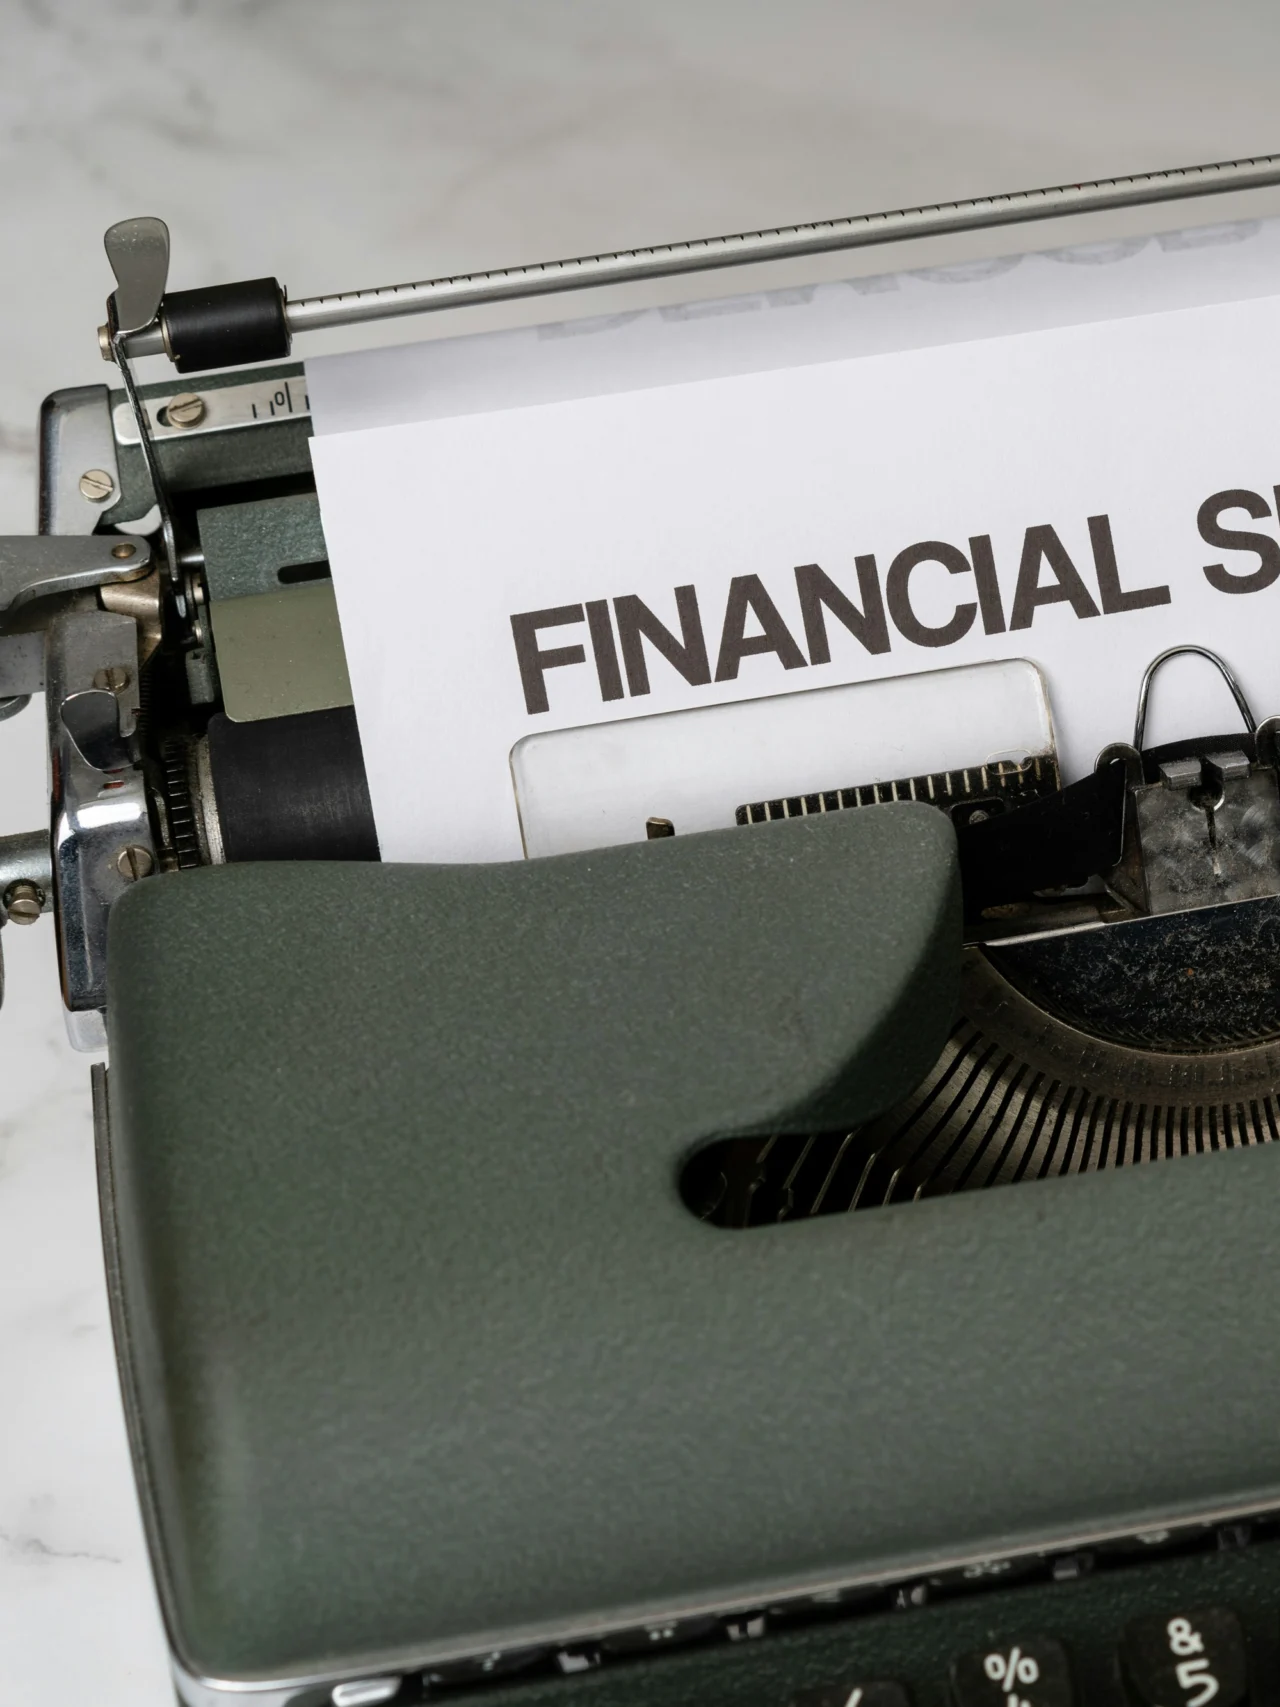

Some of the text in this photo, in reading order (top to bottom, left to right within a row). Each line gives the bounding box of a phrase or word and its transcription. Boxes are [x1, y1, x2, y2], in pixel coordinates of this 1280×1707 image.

[510, 514, 1172, 715] FINANCIAL
[983, 1646, 1040, 1693] %
[1175, 1657, 1220, 1707] 5
